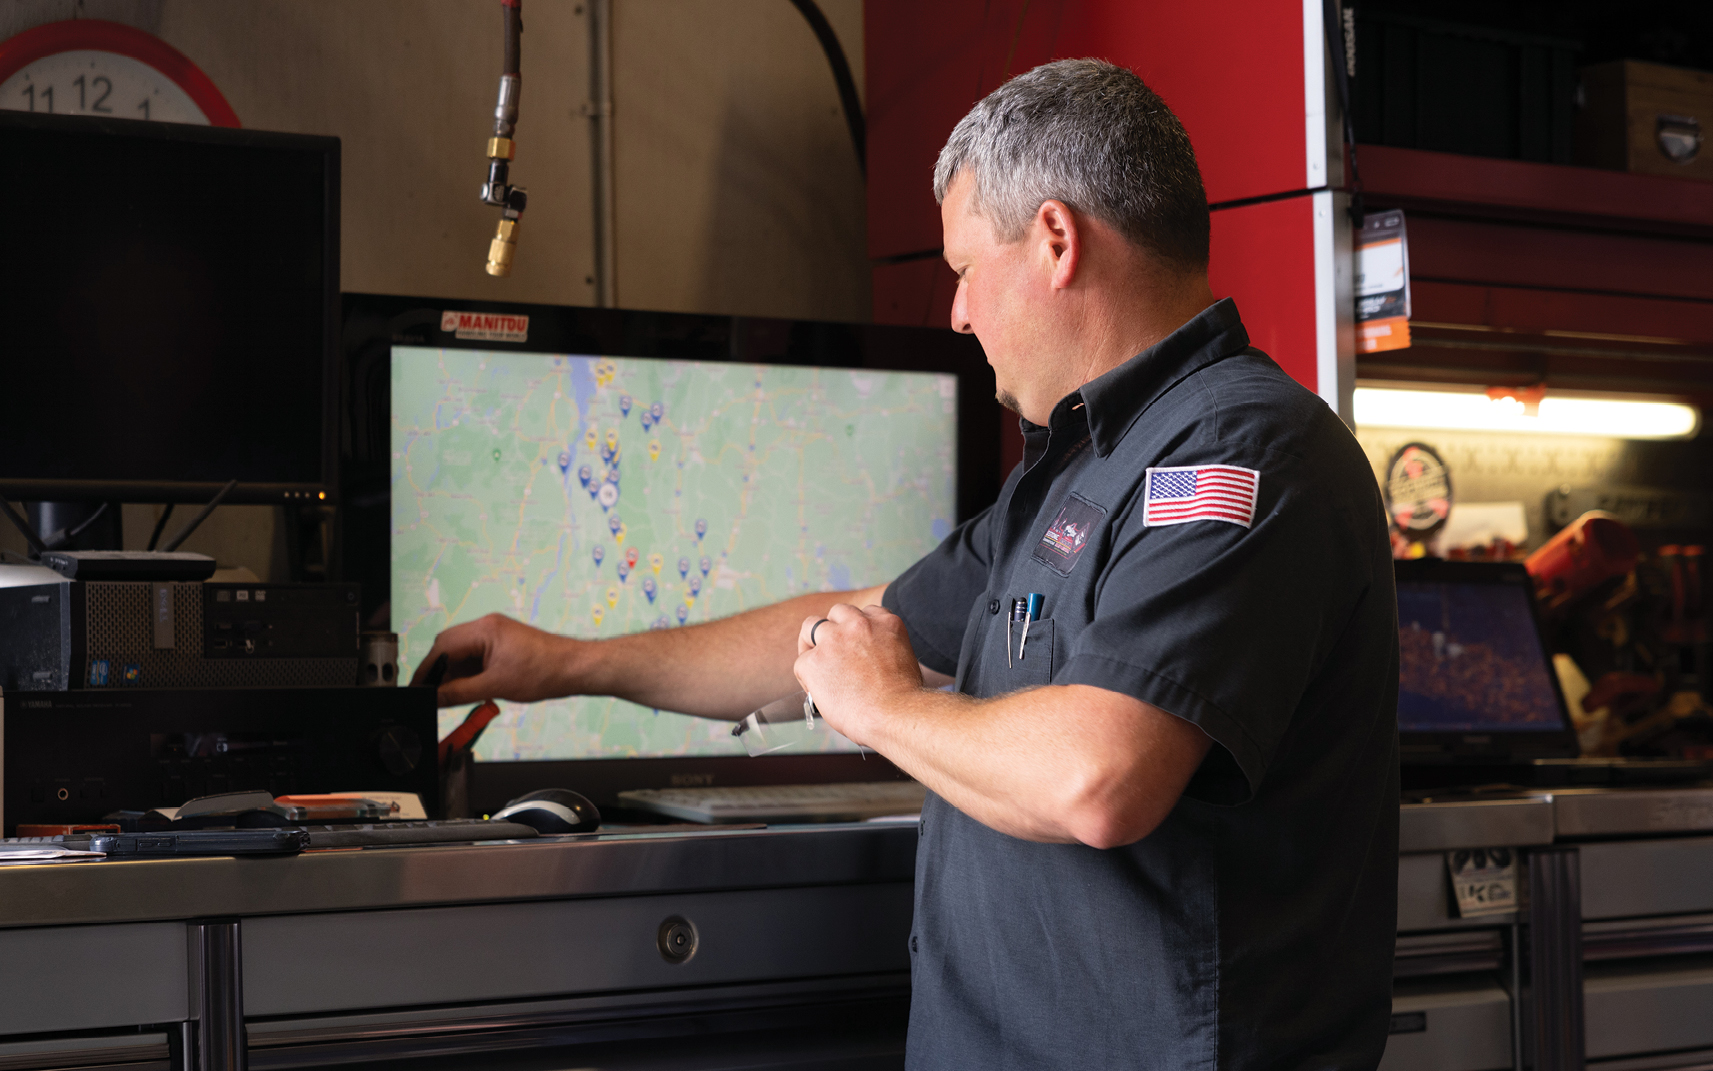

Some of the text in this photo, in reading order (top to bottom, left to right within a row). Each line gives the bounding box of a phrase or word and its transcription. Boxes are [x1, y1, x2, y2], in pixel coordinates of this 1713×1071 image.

[22, 84, 54, 113] 11
[73, 74, 113, 114] 12
[459, 315, 527, 332] MANITOU
